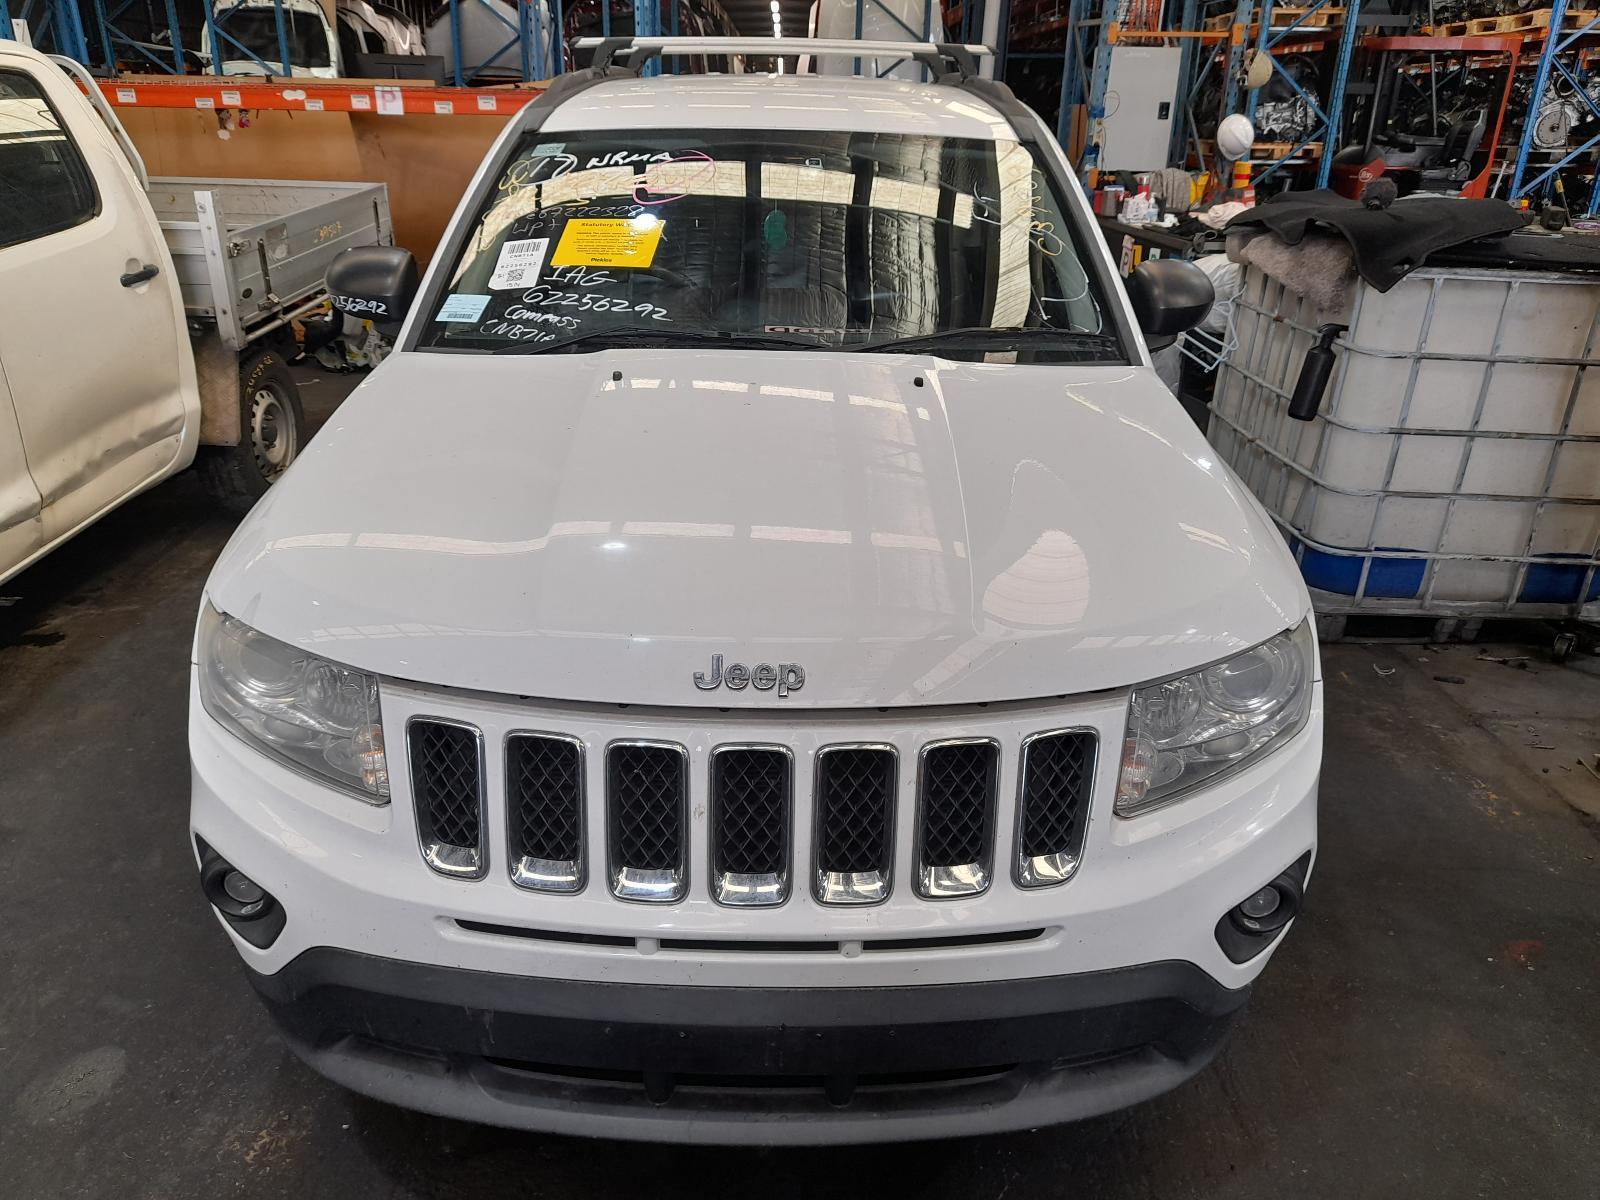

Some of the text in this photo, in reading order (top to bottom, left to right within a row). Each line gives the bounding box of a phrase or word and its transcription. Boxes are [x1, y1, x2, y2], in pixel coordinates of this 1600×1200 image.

[543, 265, 618, 286] IAG
[522, 285, 674, 322] 62256292
[693, 653, 806, 698] Jeep
